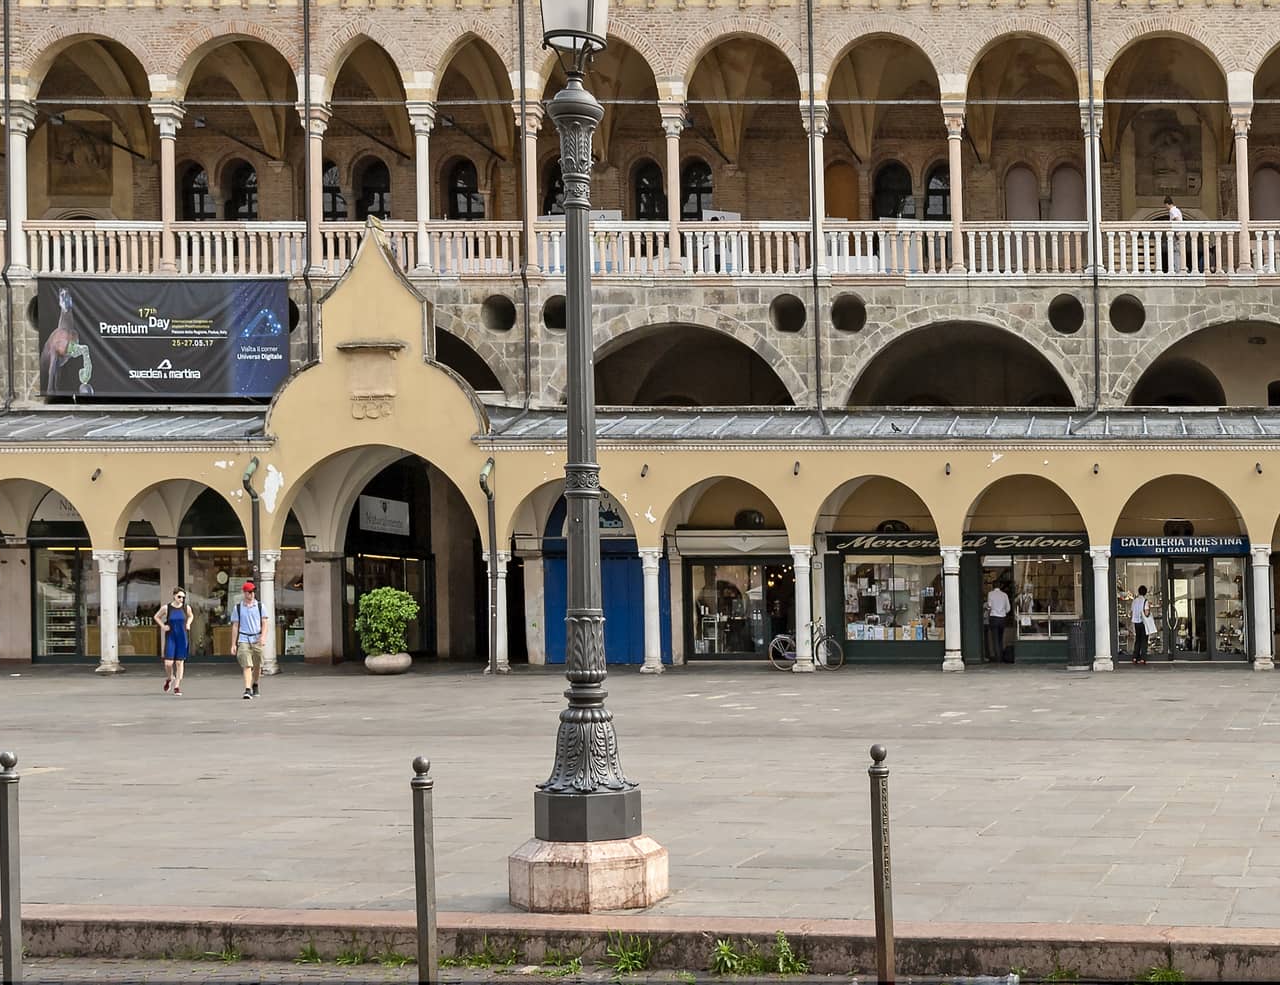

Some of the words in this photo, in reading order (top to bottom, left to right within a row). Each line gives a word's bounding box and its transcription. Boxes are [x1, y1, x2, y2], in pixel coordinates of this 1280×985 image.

[99, 322, 149, 334] Premium
[148, 316, 170, 330] Day
[171, 339, 214, 347] 25-27.05.17
[169, 368, 201, 379] martina
[836, 535, 942, 549] Merceri
[993, 535, 1084, 549] Salone
[1120, 537, 1185, 547] CALZOLERIA
[1188, 536, 1243, 547] TRIESTINA
